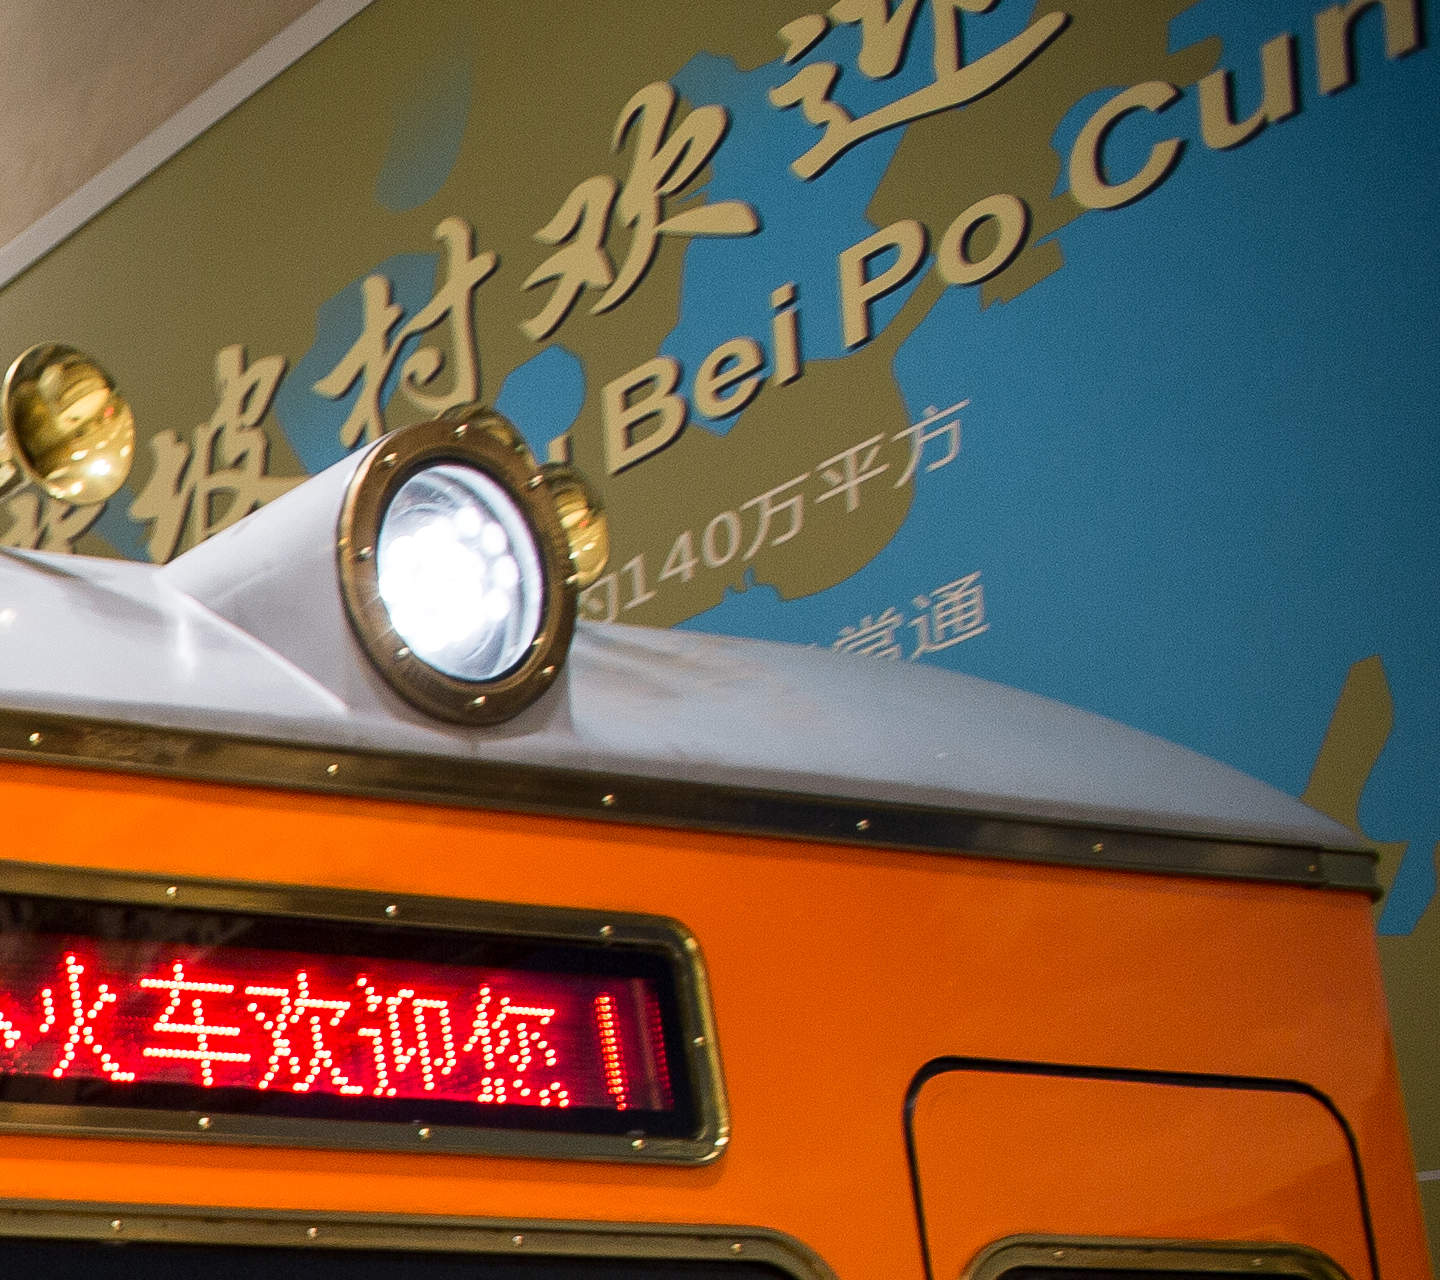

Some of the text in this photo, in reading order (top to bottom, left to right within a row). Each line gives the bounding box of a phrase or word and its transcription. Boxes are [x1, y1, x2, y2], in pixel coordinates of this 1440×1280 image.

[600, 0, 1432, 478] Bei Po Cun
